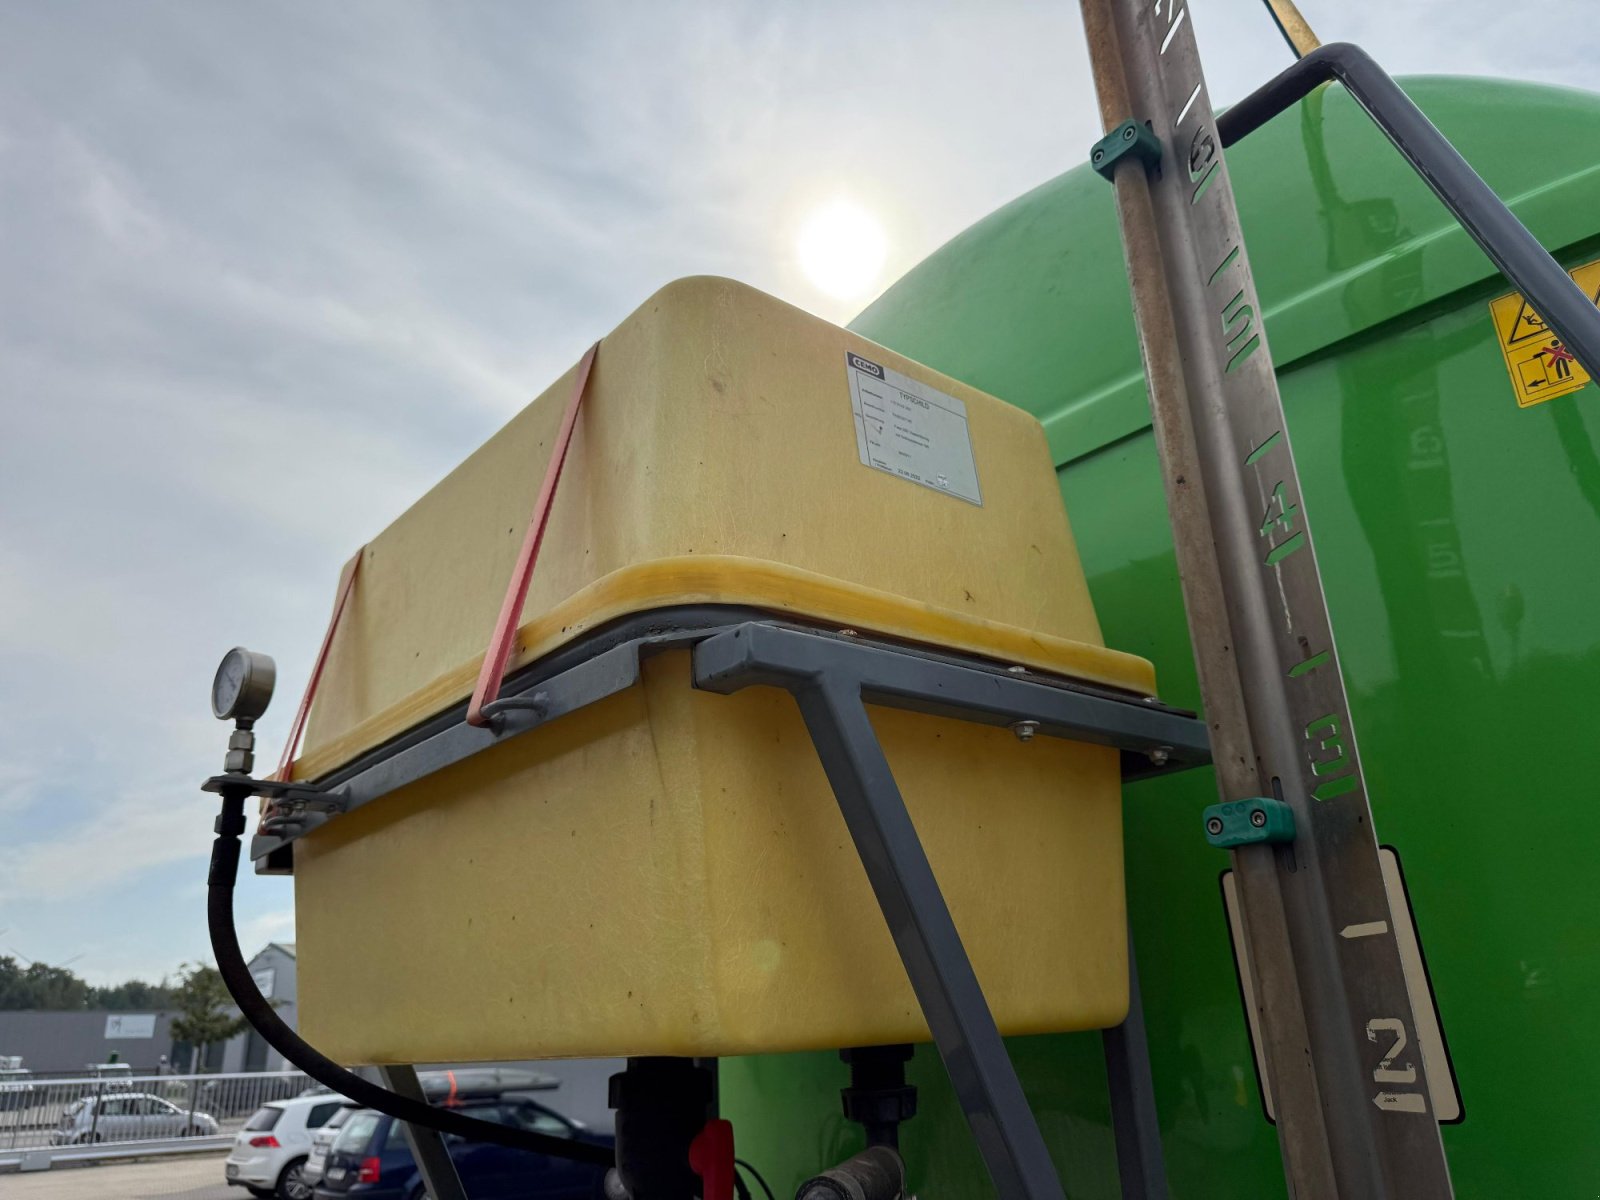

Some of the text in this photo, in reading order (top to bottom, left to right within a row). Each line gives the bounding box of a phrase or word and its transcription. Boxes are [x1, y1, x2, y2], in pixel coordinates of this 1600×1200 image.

[1188, 125, 1215, 183] 6
[1222, 290, 1254, 351] 5
[855, 358, 878, 374] CEMO
[1260, 481, 1296, 536] 4
[1305, 713, 1350, 776] 3
[1366, 1018, 1416, 1083] 2
